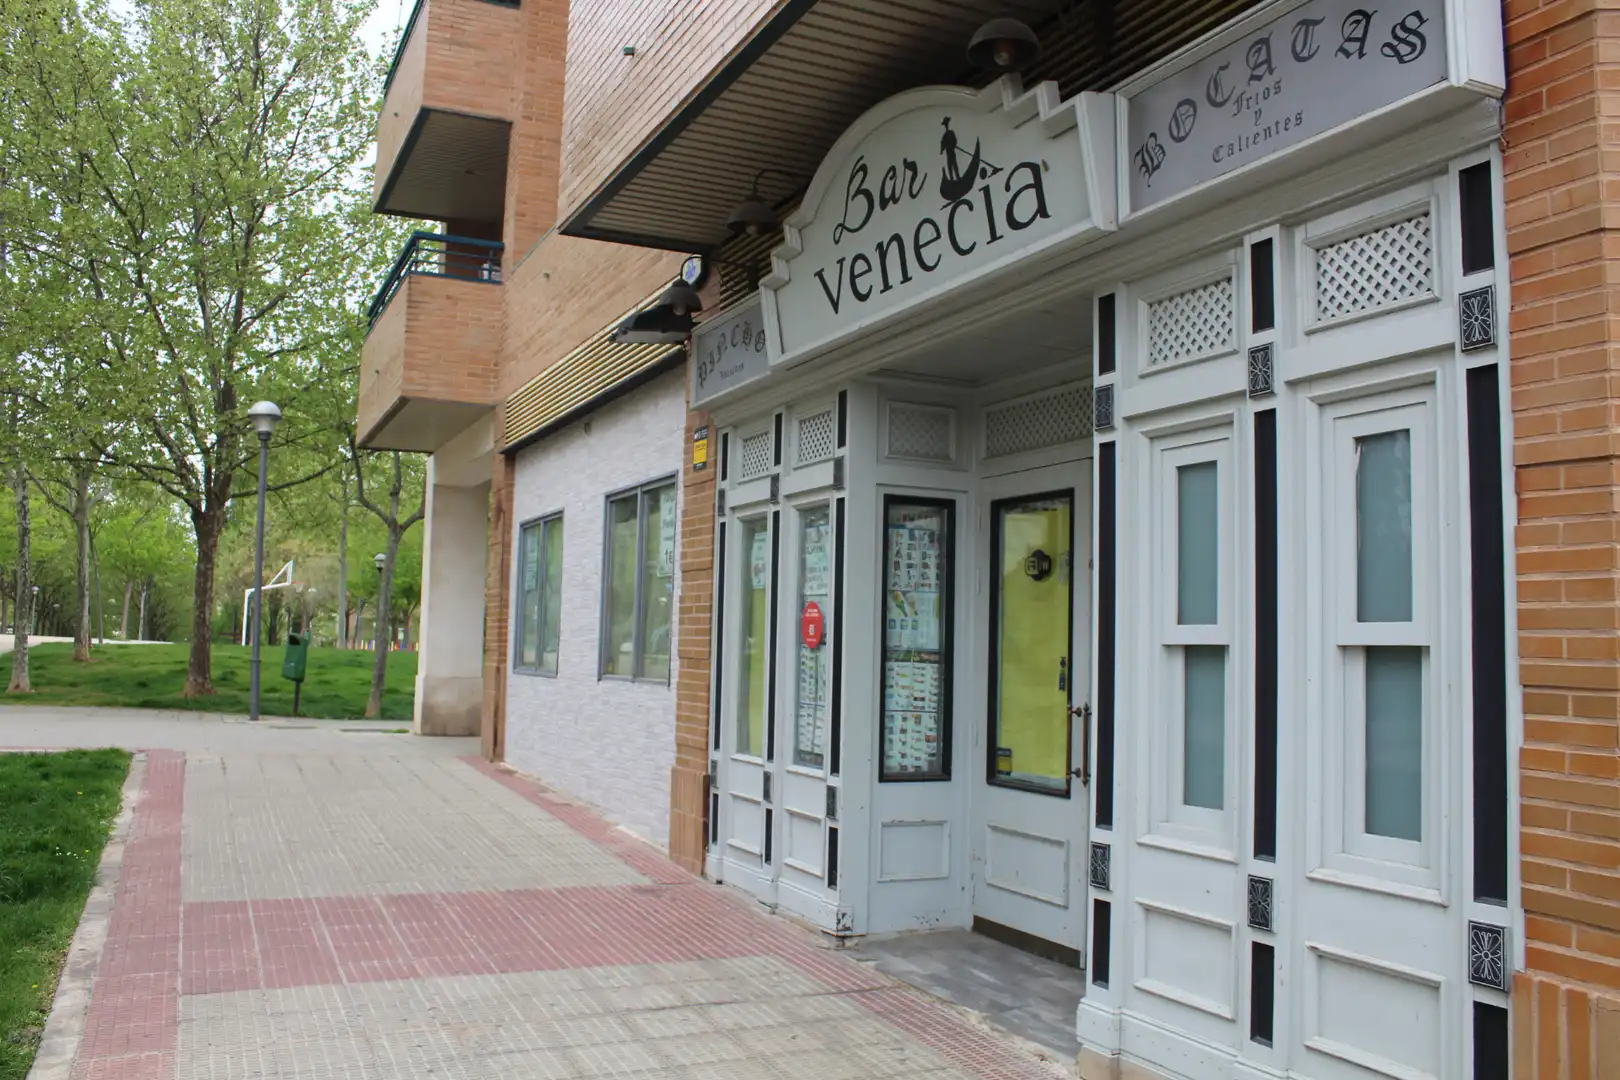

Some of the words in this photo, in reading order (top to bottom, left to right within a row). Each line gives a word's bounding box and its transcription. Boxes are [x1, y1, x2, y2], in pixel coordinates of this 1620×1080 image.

[1133, 9, 1429, 187] BOCATAS
[1212, 110, 1304, 163] Calientes
[833, 154, 928, 245] Bar
